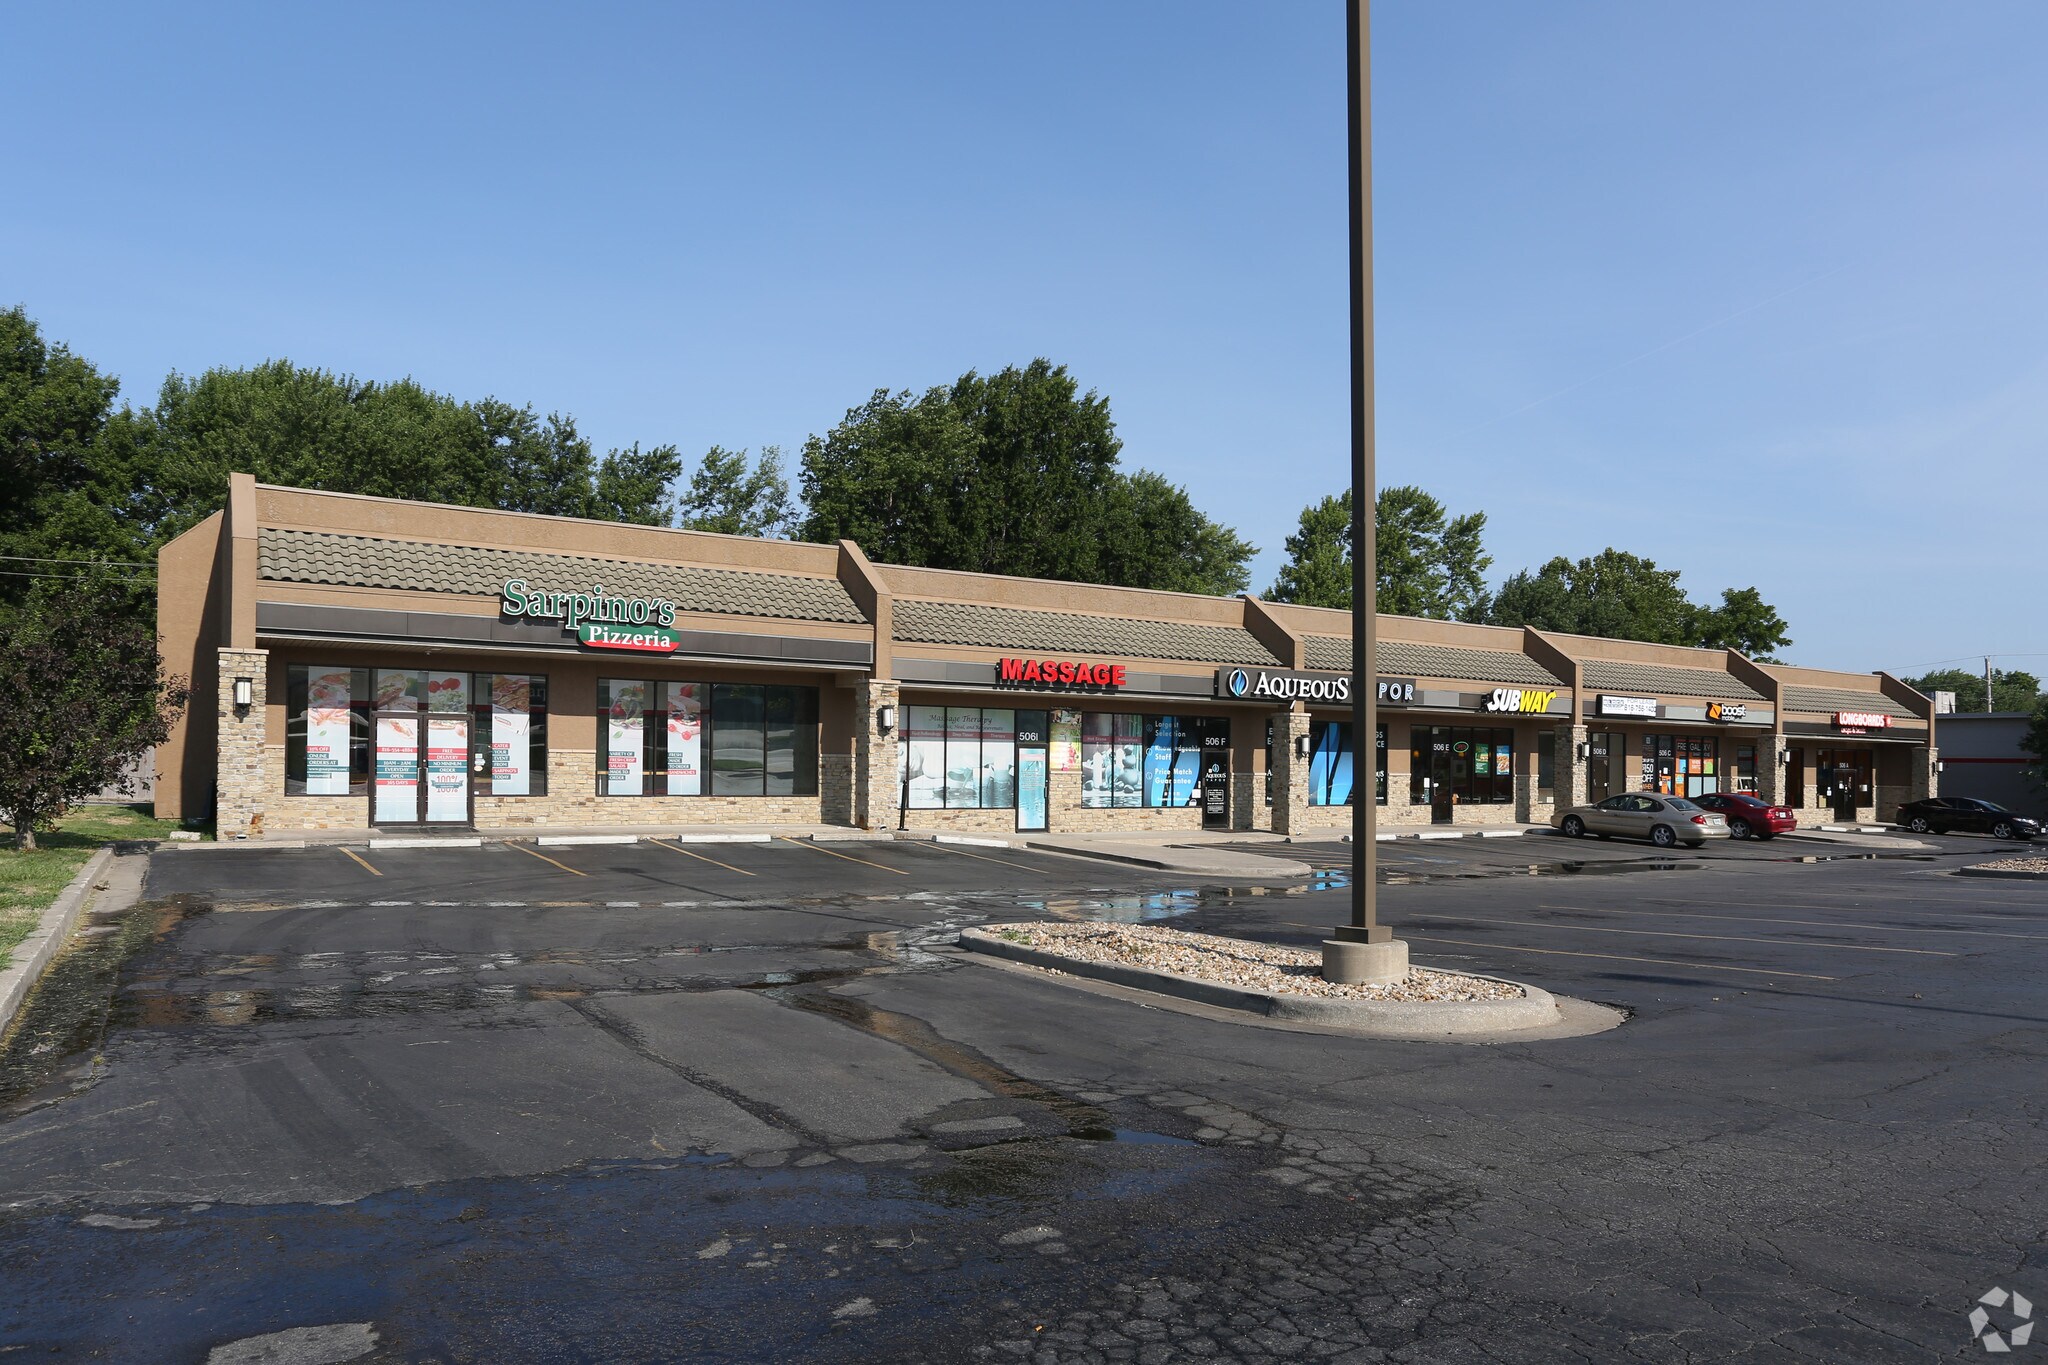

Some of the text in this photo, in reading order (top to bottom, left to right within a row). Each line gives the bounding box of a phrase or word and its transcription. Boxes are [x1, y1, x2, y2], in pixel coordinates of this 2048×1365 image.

[503, 579, 676, 630] Sarpino's
[588, 626, 671, 648] Pizzeria
[1001, 658, 1126, 686] MASSAGE
[1254, 672, 1414, 700] AQUEOUS POR
[1487, 688, 1557, 714] SUBWAY
[1721, 704, 1746, 716] boost
[928, 714, 960, 724] Masage
[1840, 712, 1885, 727] LONGBOARDS
[1205, 737, 1226, 746] 506 F
[1690, 743, 1711, 751] GALXY
[1155, 744, 1201, 753] Knowedgeable
[1642, 774, 1654, 782] OFF
